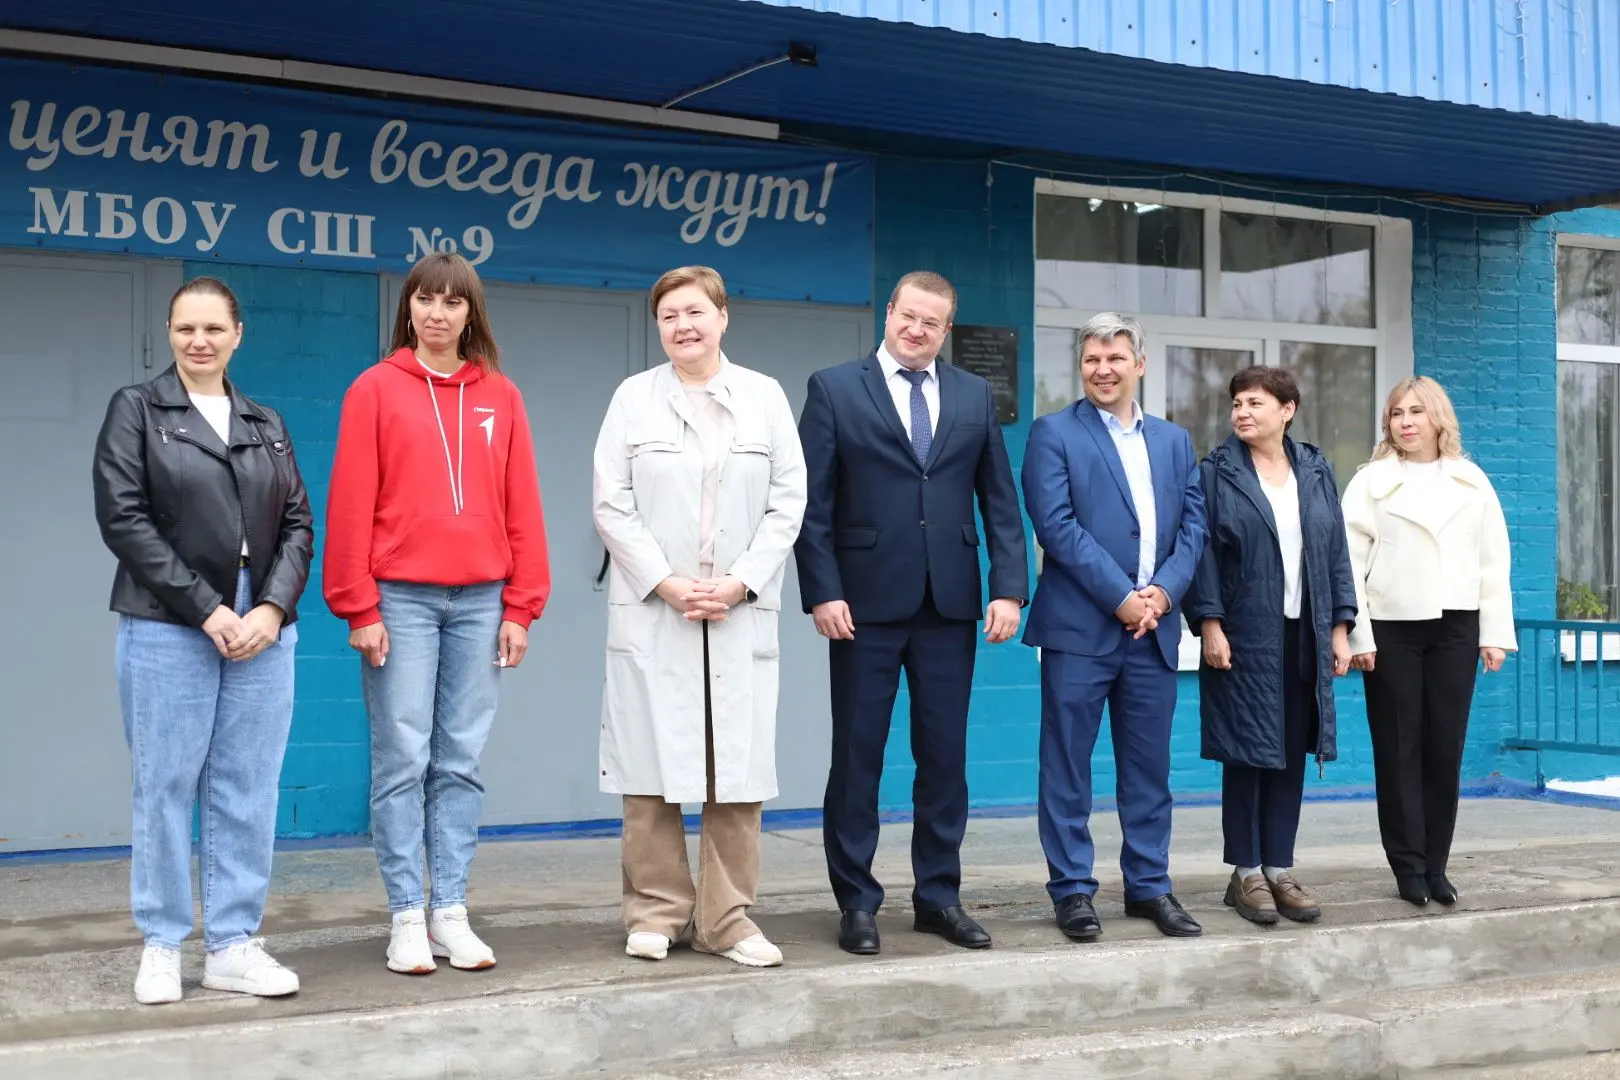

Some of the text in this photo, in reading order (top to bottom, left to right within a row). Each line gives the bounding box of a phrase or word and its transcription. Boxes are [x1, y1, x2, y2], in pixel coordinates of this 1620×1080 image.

[9, 100, 837, 248] ценят и всегда ждут!
[27, 187, 237, 252] МБОУ
[267, 208, 376, 260] СШ
